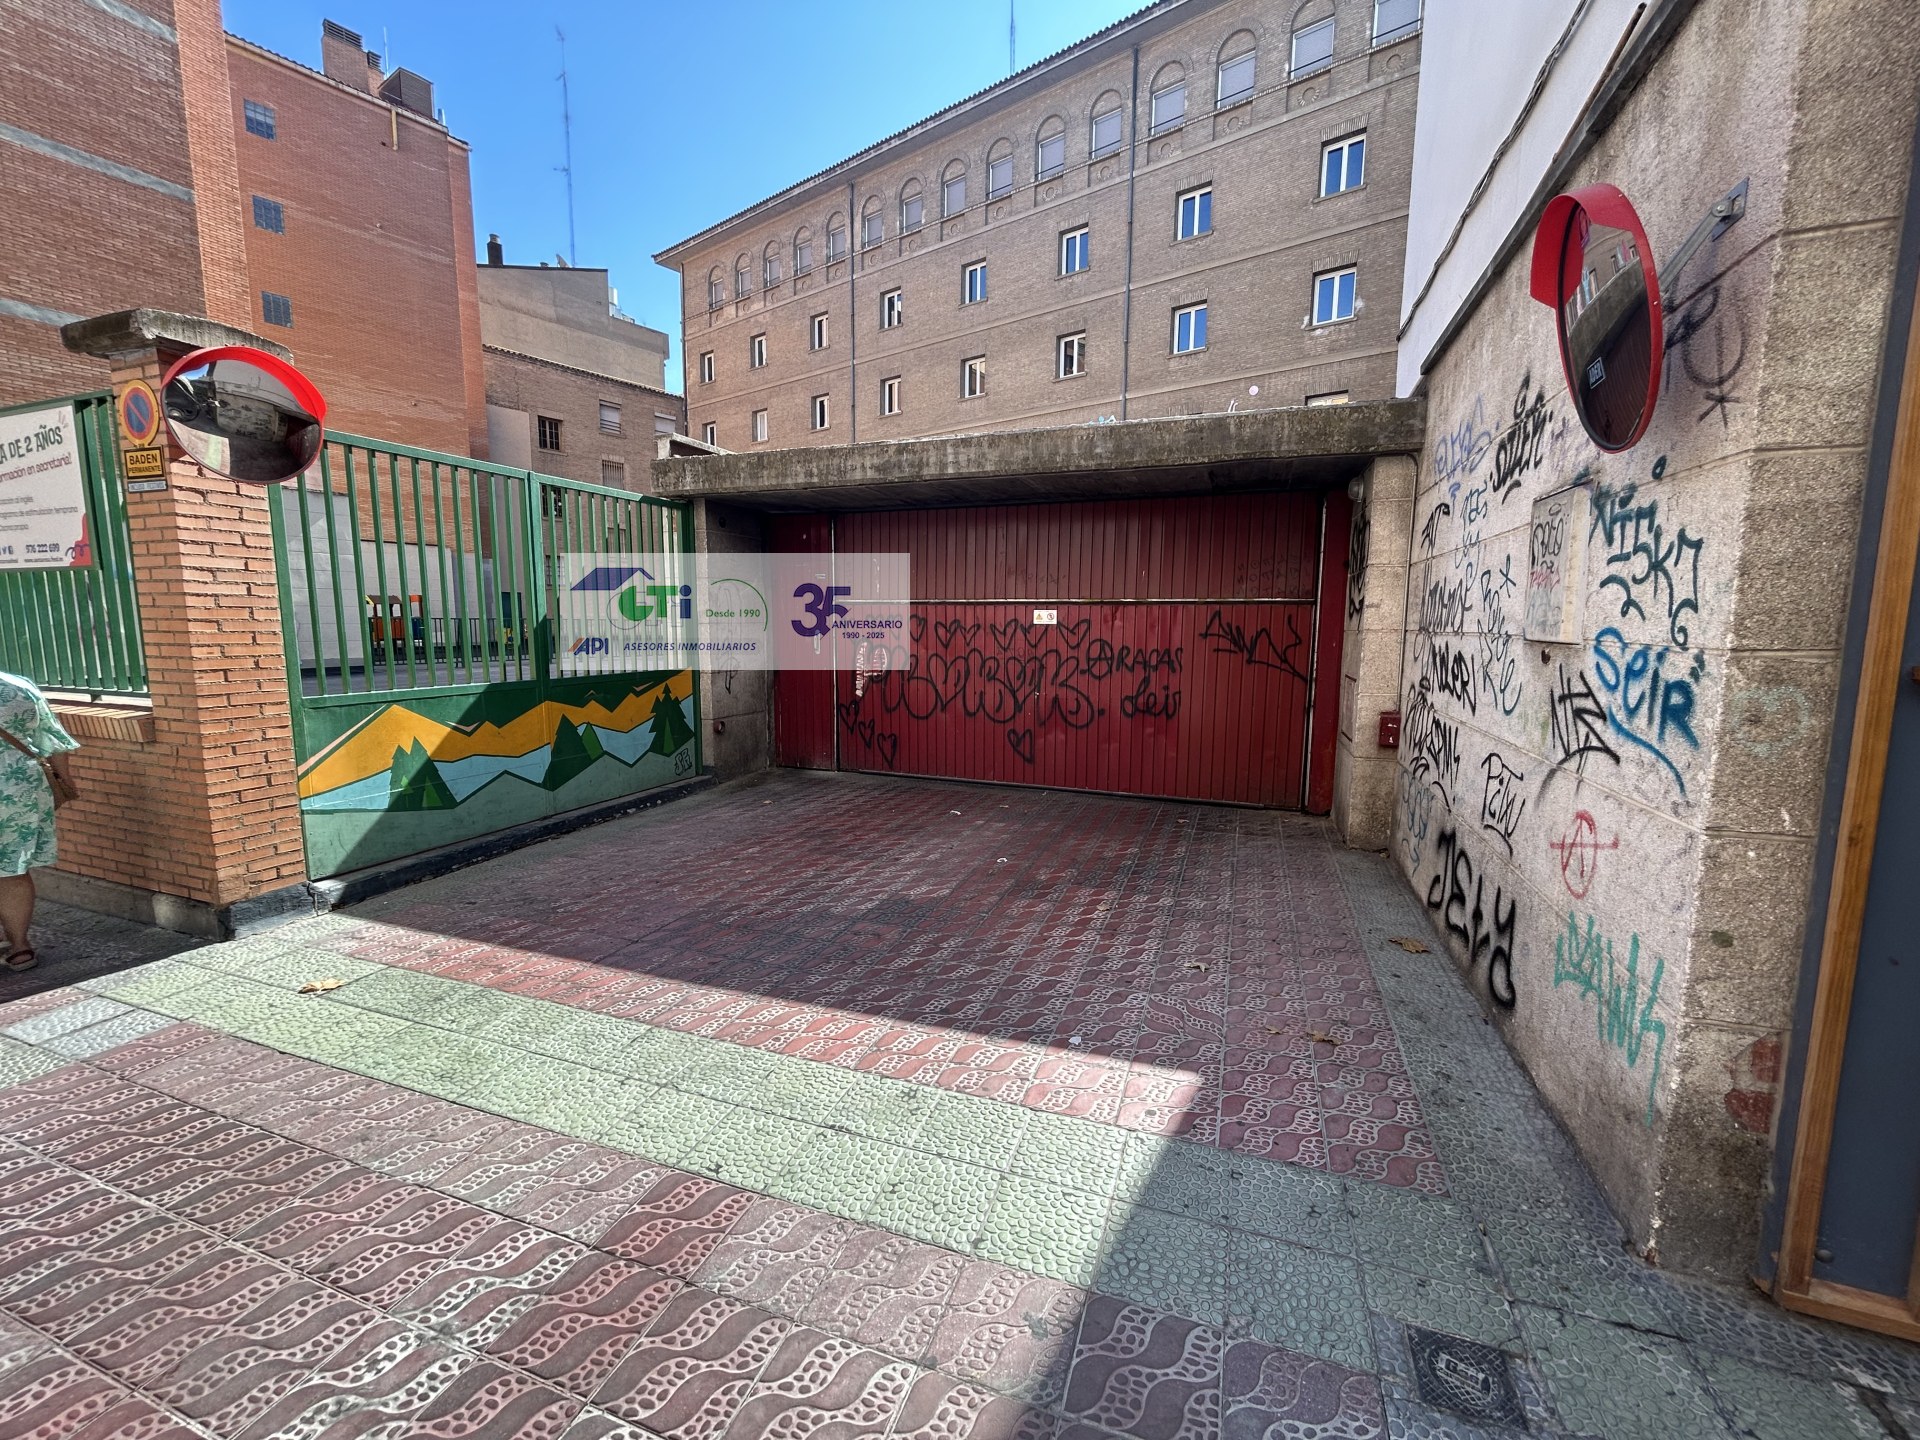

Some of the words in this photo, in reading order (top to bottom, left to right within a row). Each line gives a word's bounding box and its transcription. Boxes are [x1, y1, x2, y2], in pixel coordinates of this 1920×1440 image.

[8, 438, 26, 459] DE
[24, 435, 33, 455] 2
[34, 424, 63, 453] AÑOS
[129, 453, 158, 465] BADEN
